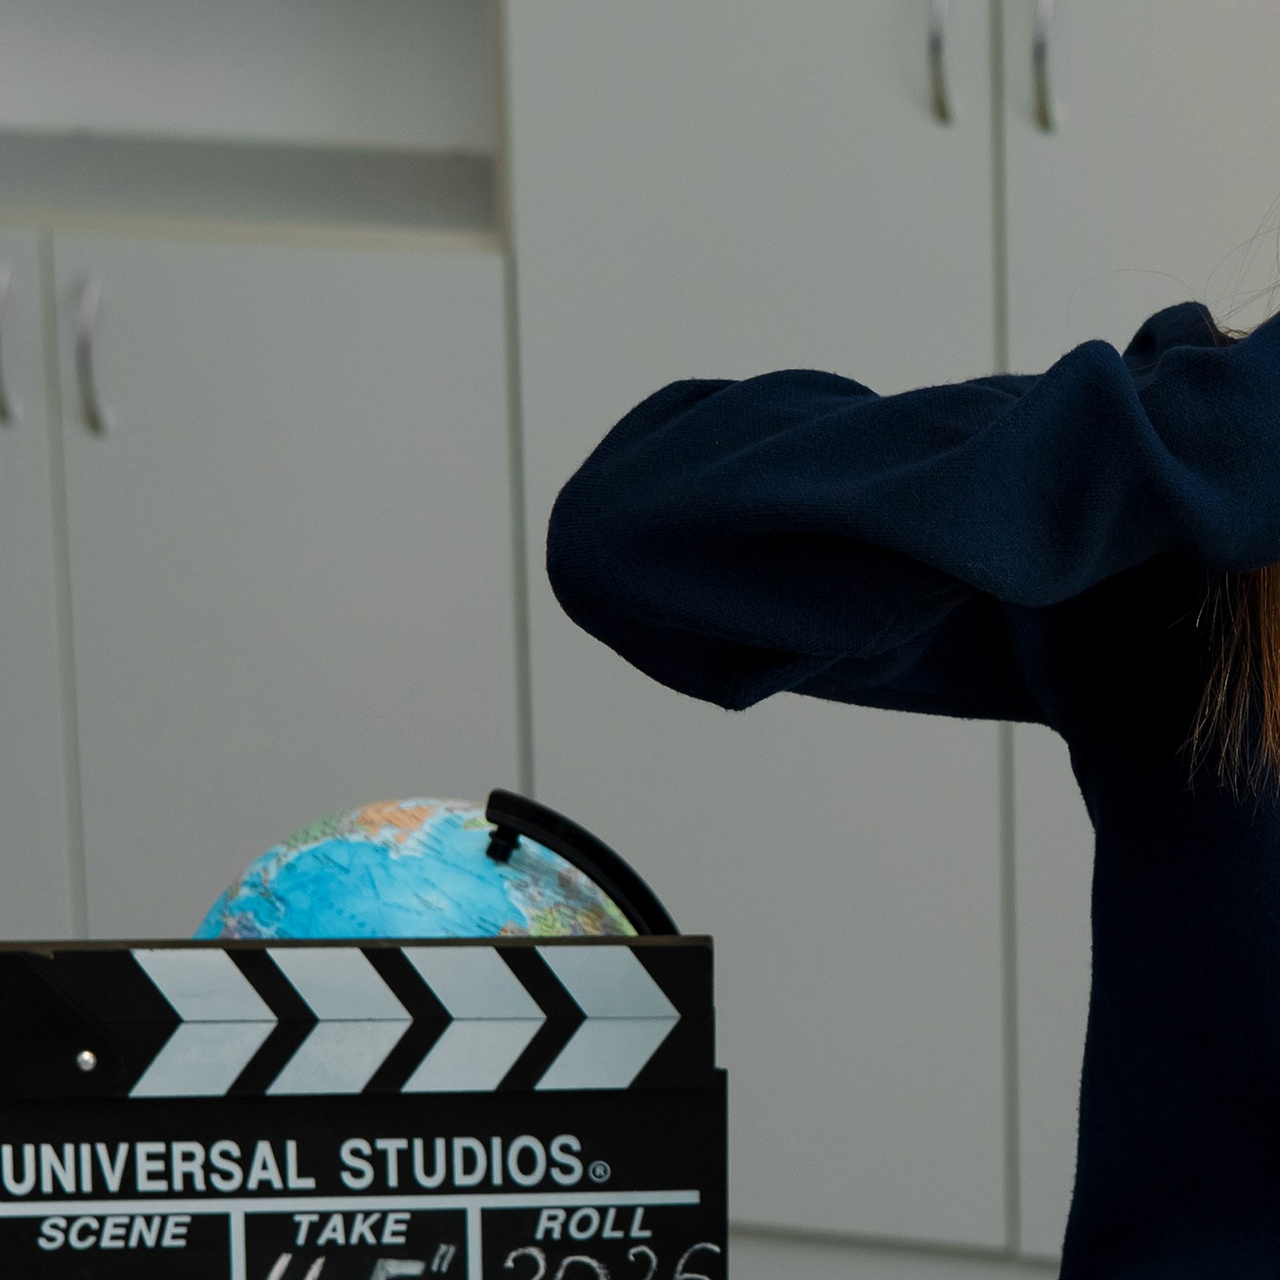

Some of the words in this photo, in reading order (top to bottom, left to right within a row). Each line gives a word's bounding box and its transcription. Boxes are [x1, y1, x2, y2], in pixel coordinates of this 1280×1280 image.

[1, 1139, 316, 1196] UNIVERSAL
[37, 1214, 192, 1251] SCENE
[293, 1212, 411, 1246] TAKE
[534, 1207, 653, 1241] ROLL
